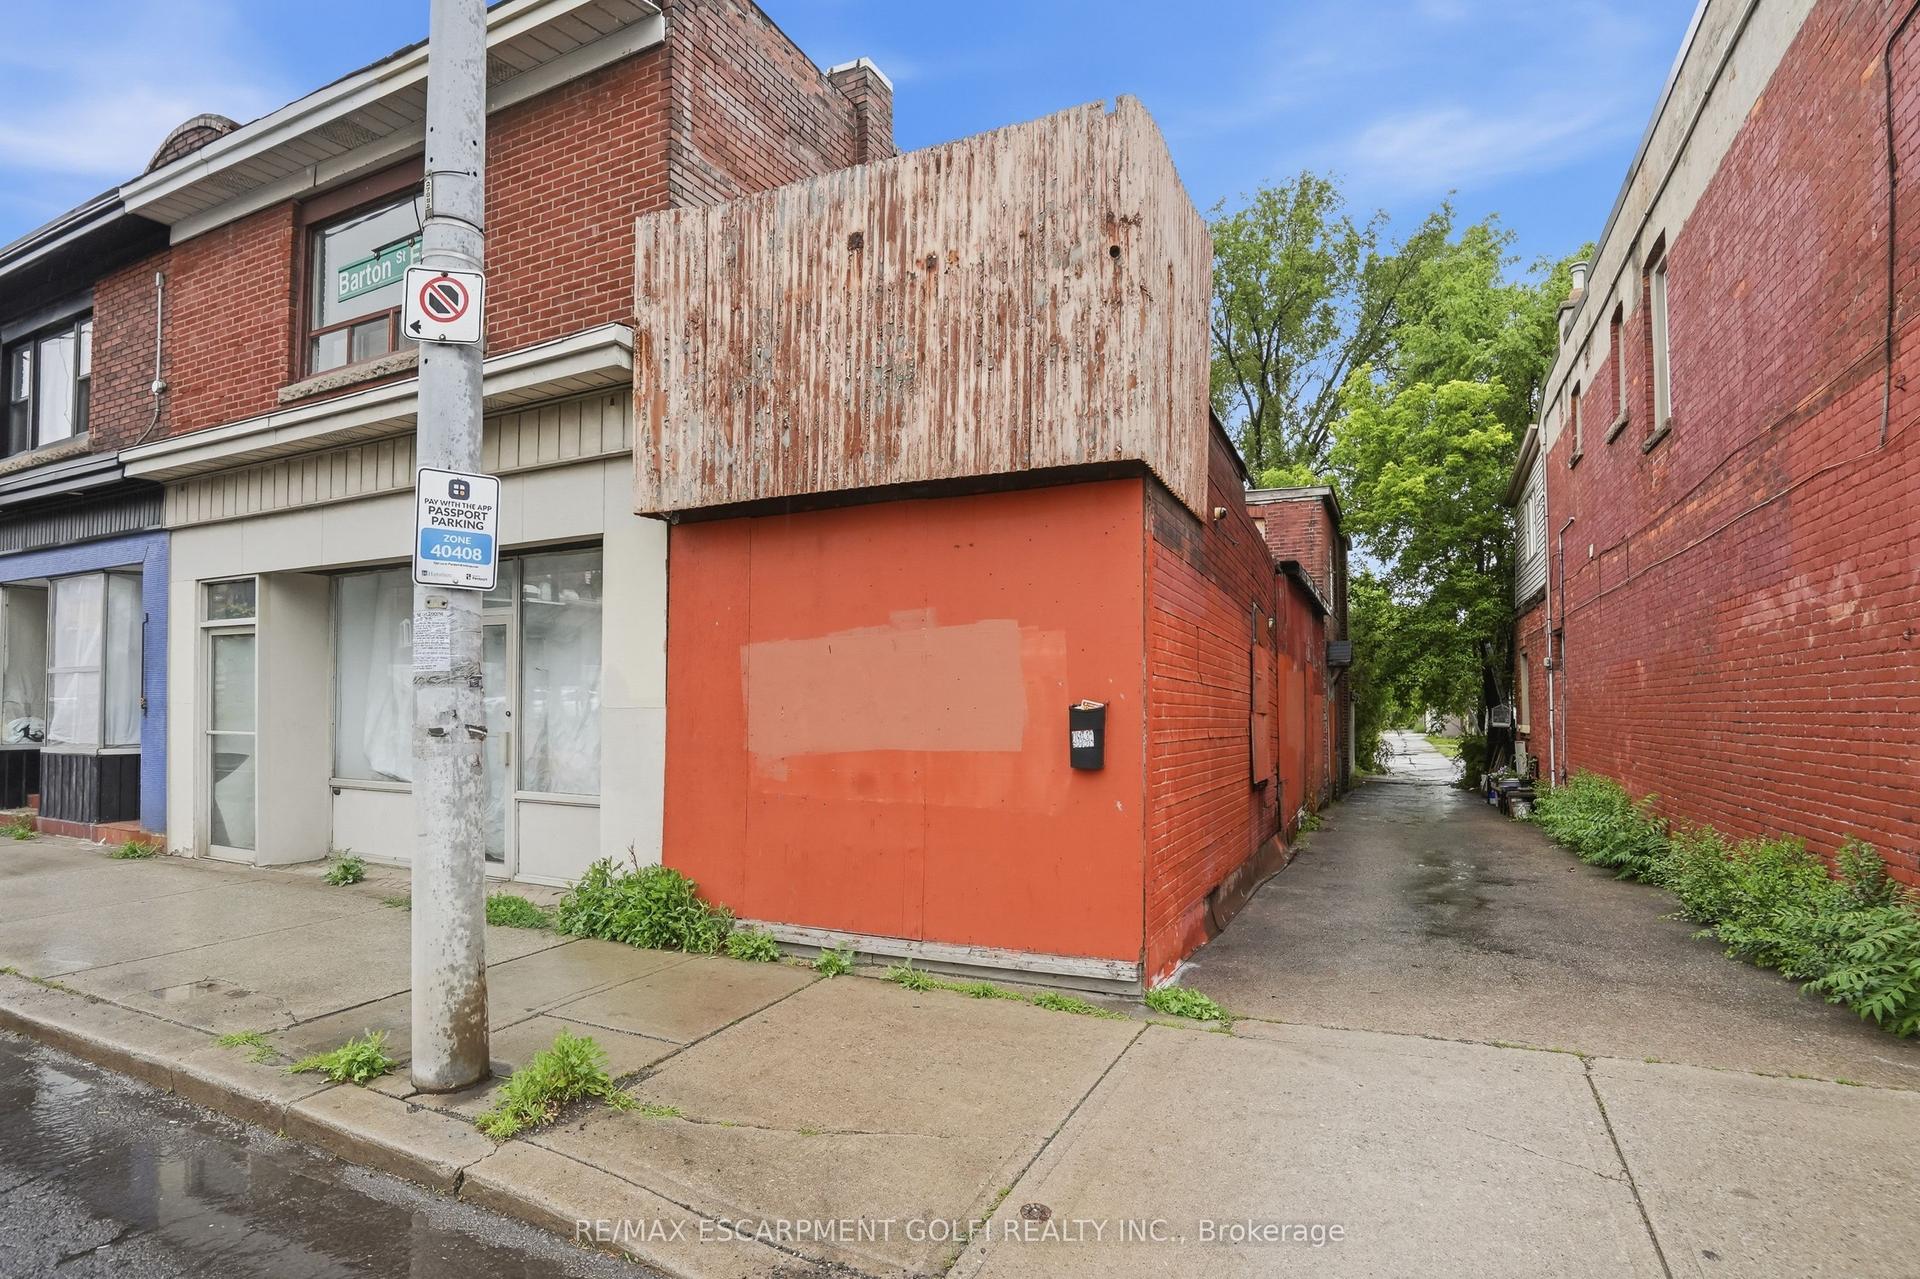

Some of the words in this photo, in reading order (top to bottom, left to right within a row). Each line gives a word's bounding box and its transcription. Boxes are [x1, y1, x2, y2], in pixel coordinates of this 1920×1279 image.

[340, 261, 391, 295] Barton
[424, 497, 438, 505] PAY
[440, 499, 461, 508] WITH
[462, 502, 476, 511] THE
[477, 504, 493, 512] APP
[428, 505, 488, 521] PASSPORT
[431, 516, 484, 531] PARKING
[443, 534, 472, 545] ZONE
[430, 544, 482, 560] 40408
